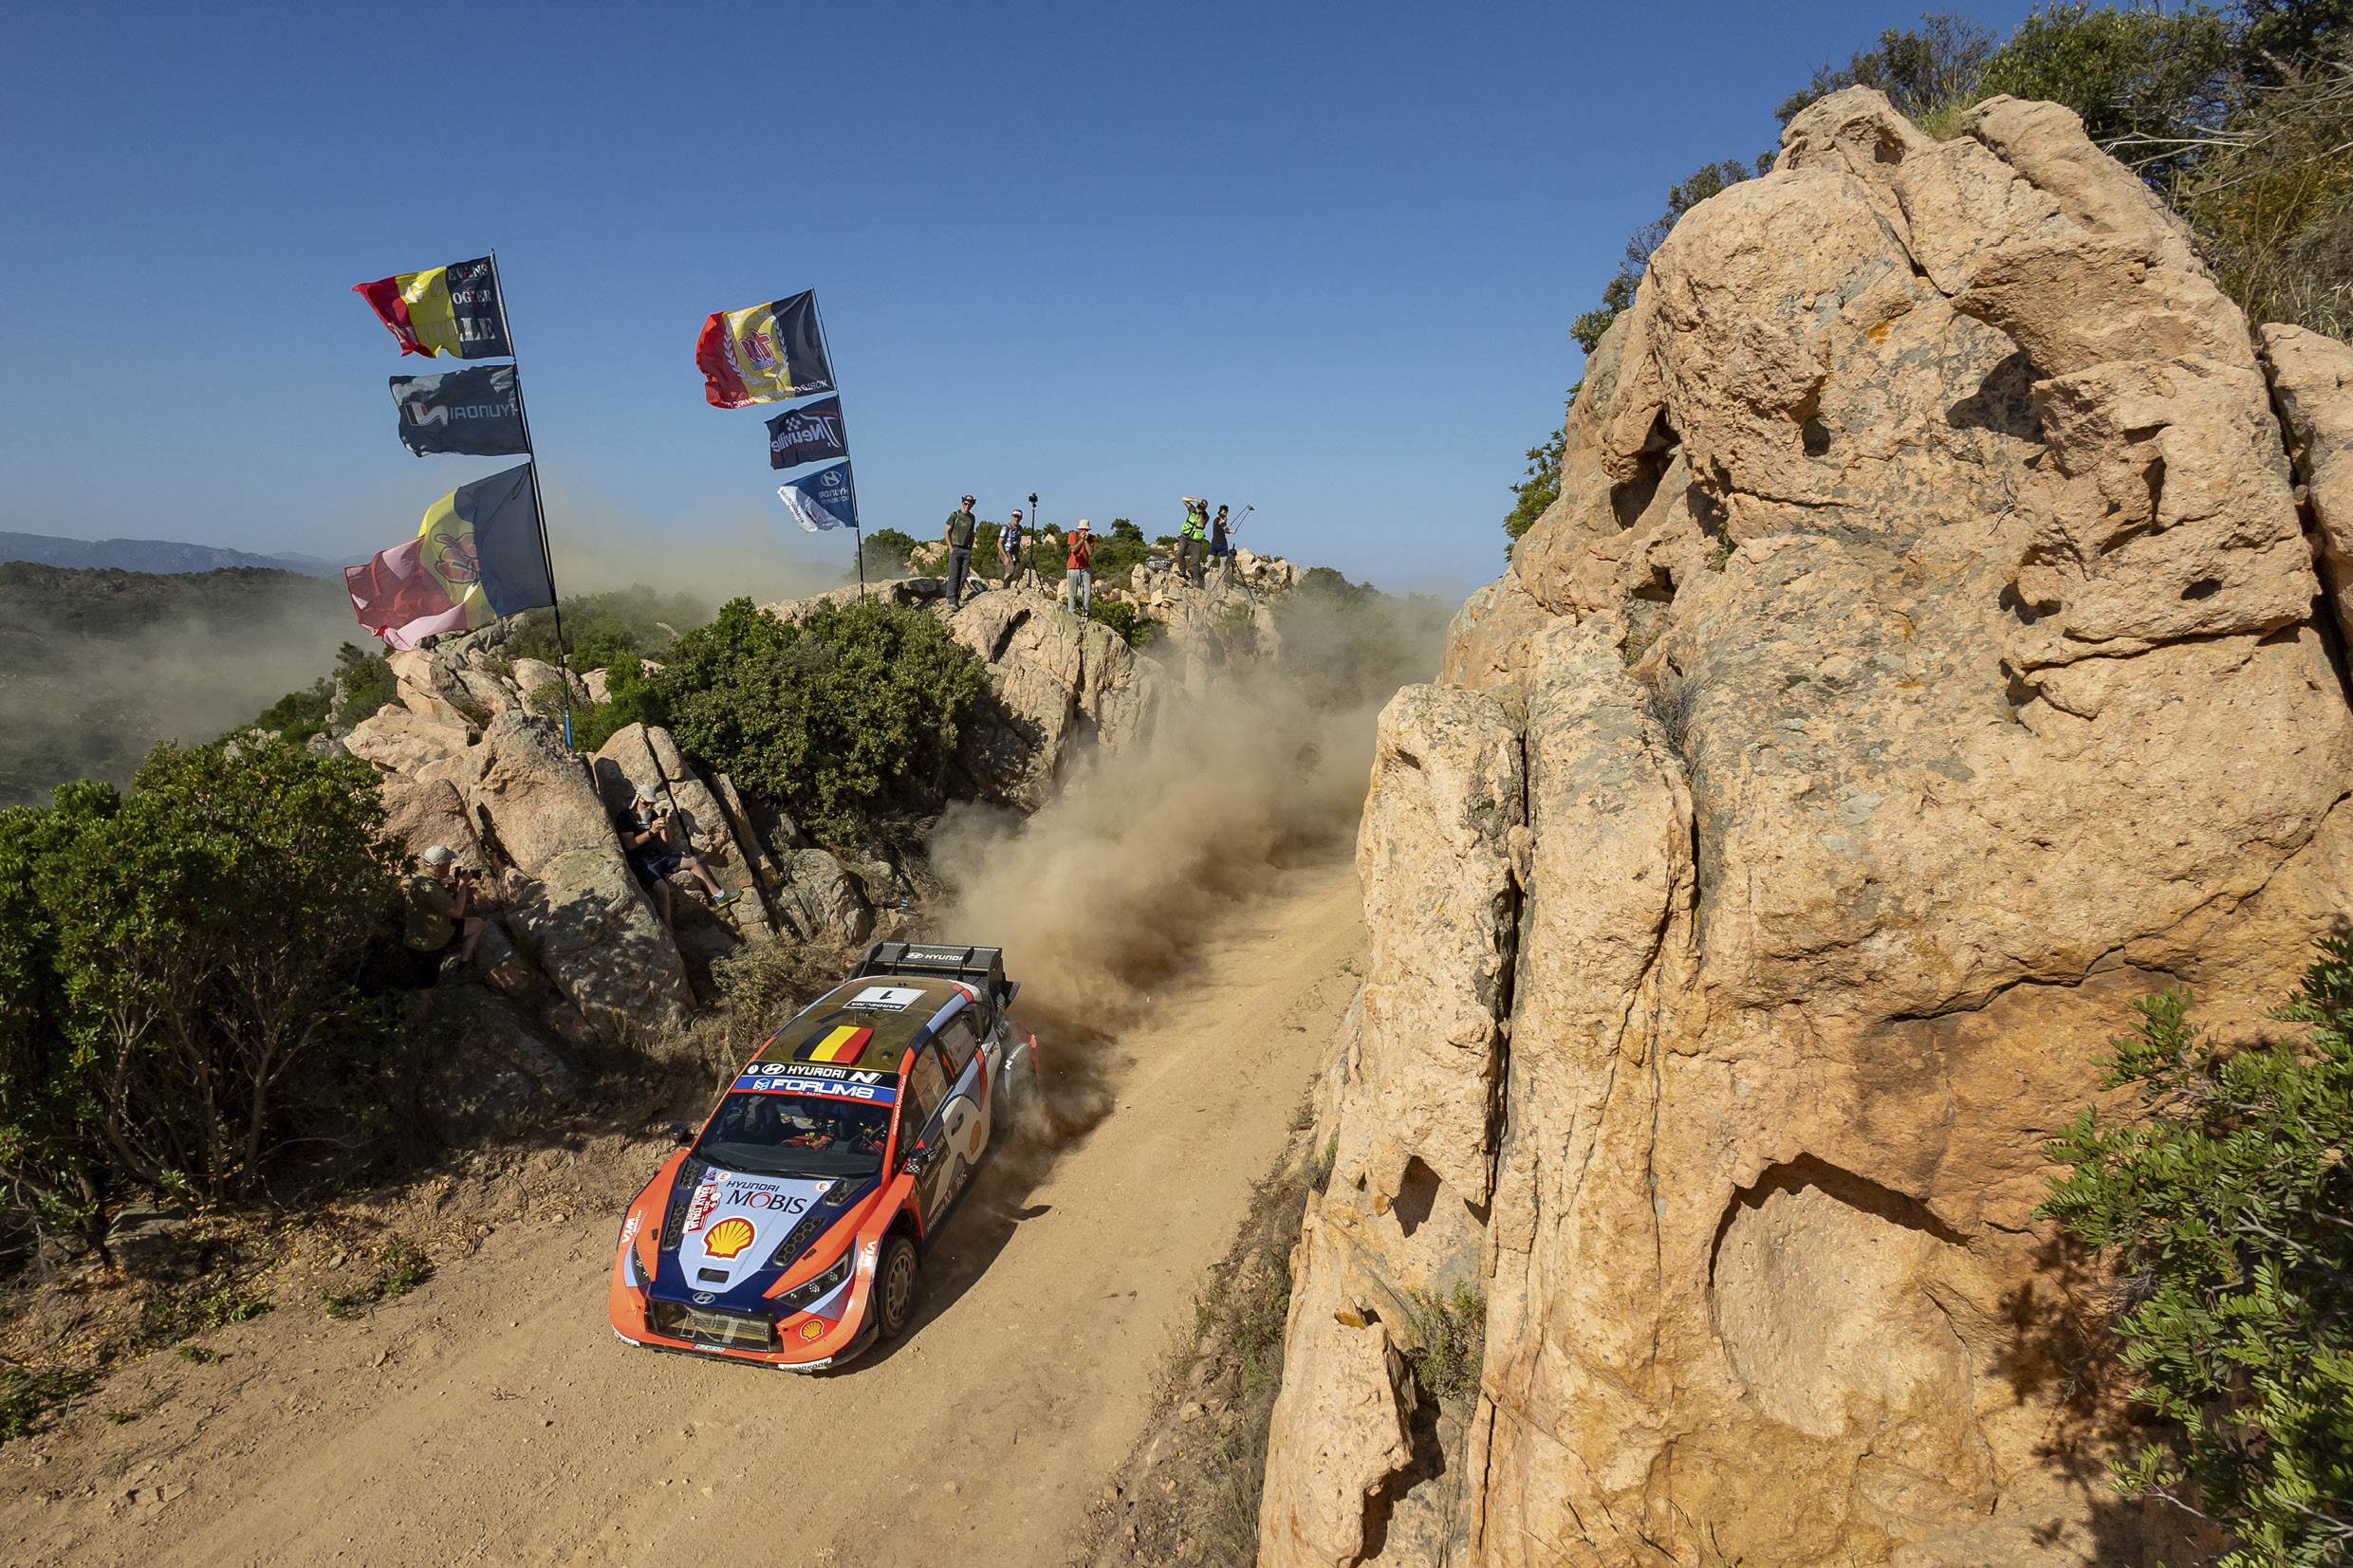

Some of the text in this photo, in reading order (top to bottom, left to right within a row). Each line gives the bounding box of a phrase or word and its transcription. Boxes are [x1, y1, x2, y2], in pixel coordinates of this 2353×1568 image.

[879, 990, 894, 1001] 1
[787, 1065, 847, 1079] HYUNDAI
[770, 1079, 876, 1099] FORUM8
[726, 1180, 781, 1192] HYUNDAI
[689, 1186, 712, 1230] RALLY ITALIA
[726, 1189, 807, 1214] MOBIS
